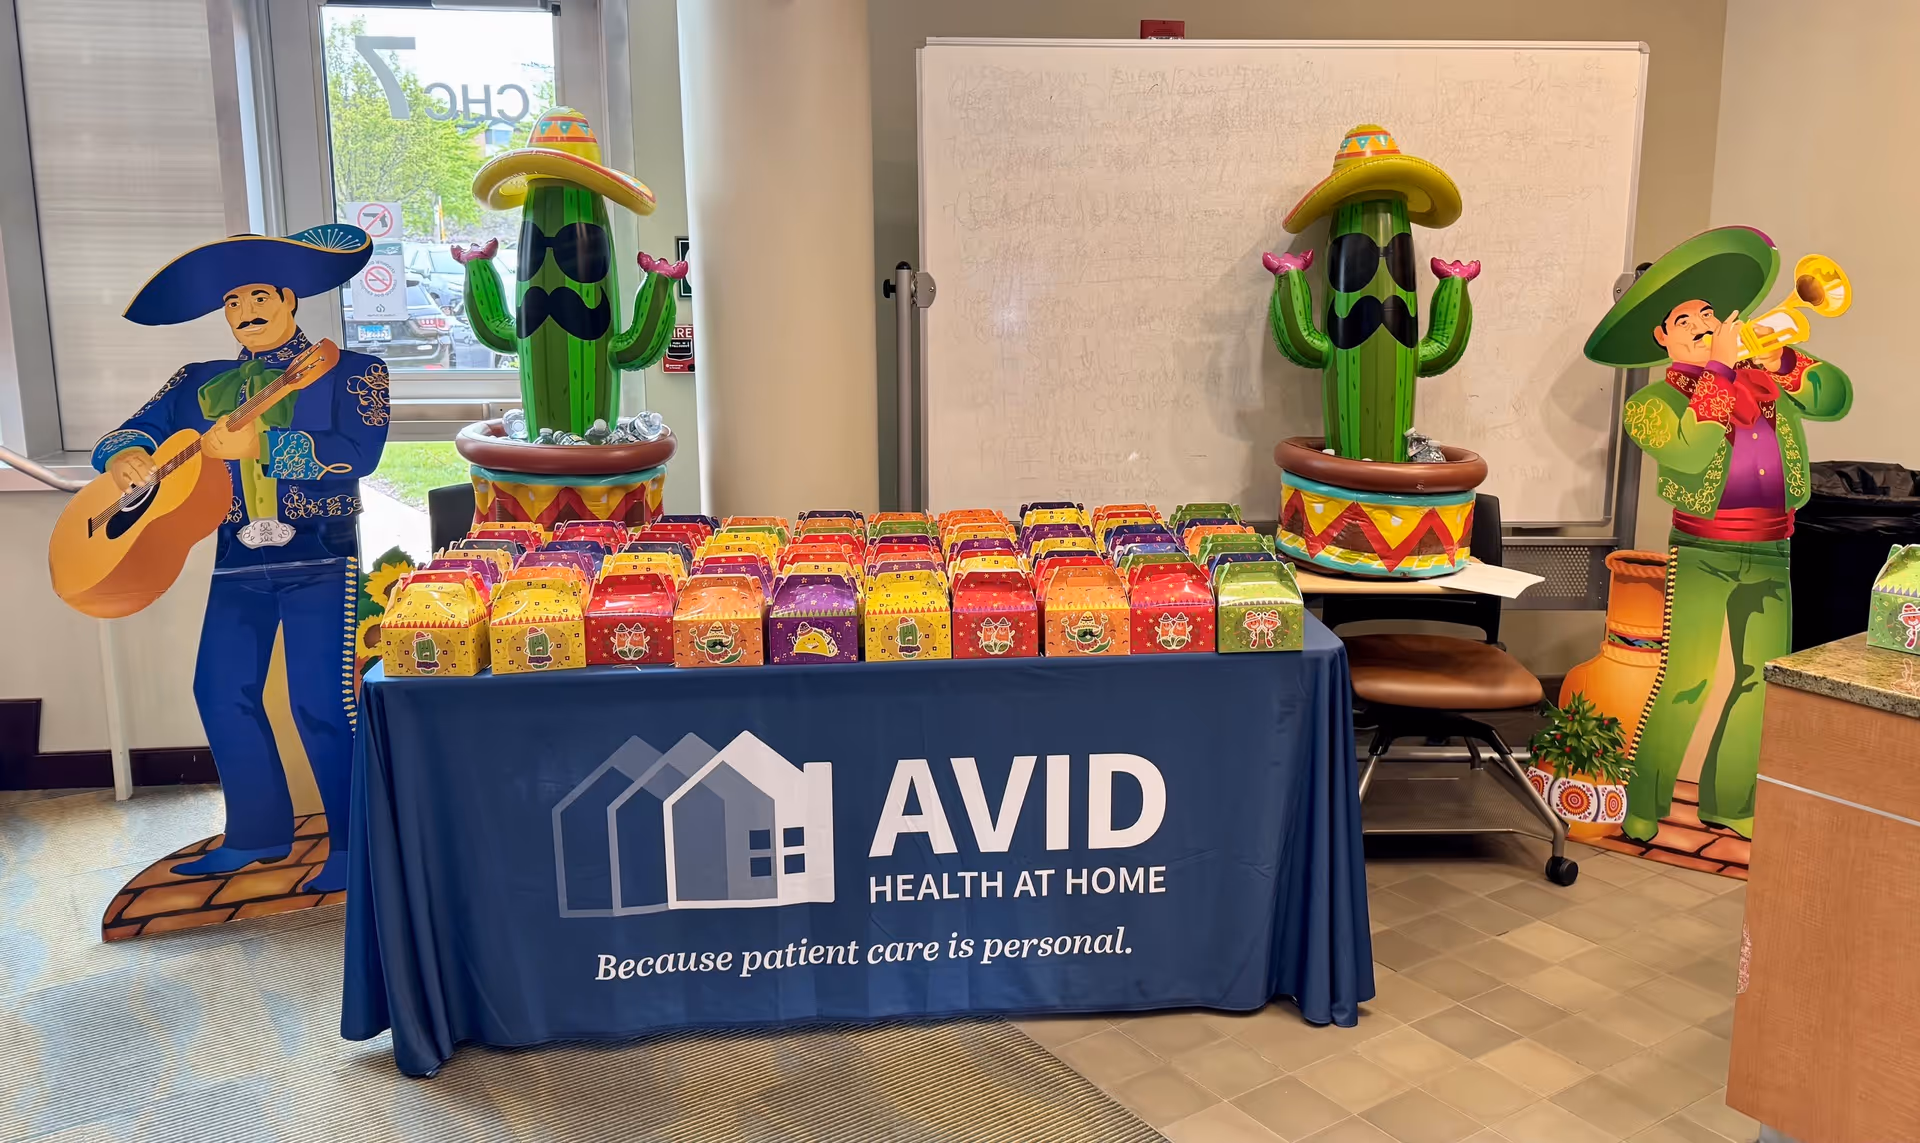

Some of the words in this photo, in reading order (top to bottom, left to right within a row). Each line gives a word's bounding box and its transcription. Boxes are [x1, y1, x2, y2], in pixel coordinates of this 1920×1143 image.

[672, 327, 693, 338] IRE
[868, 752, 1167, 858] AVID
[869, 870, 1004, 904] HEALTH
[1013, 869, 1056, 898] AT
[1066, 865, 1167, 895] HOME
[594, 952, 733, 981] Because
[739, 937, 860, 978] patient
[867, 941, 940, 966] care
[947, 931, 975, 959] is
[979, 926, 1133, 966] personal.
